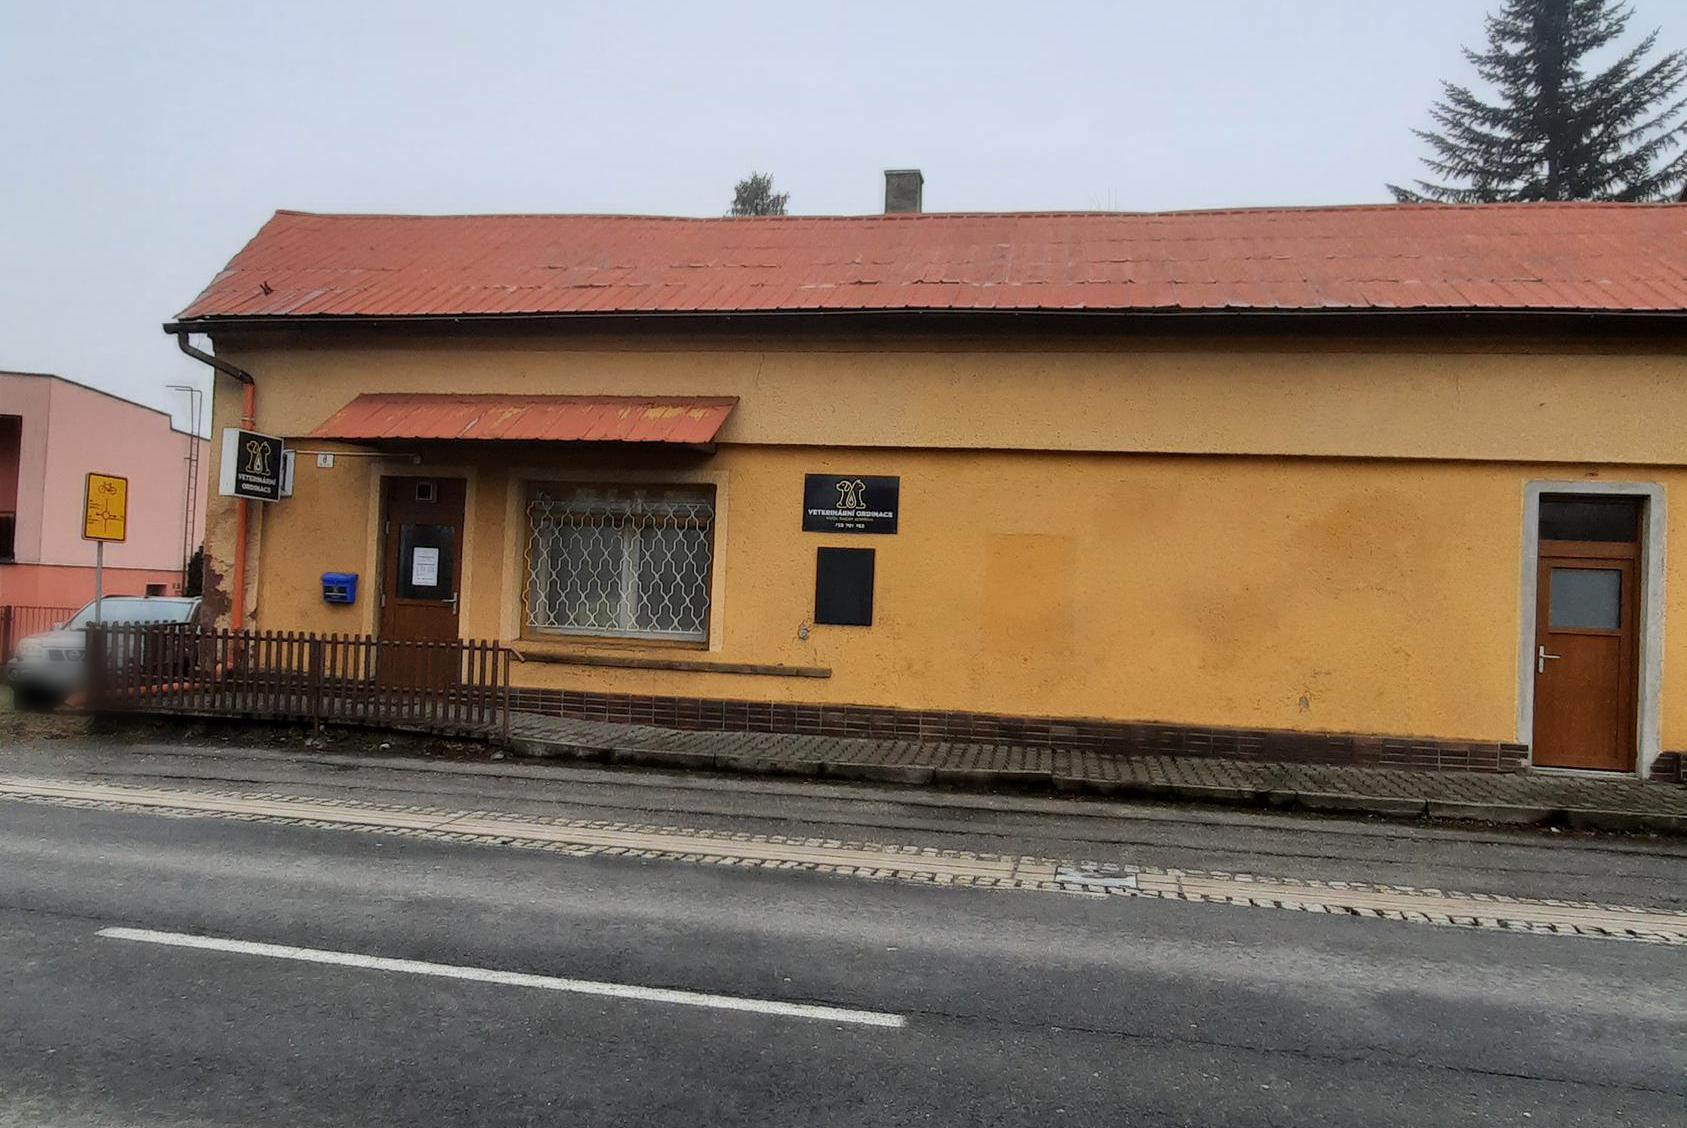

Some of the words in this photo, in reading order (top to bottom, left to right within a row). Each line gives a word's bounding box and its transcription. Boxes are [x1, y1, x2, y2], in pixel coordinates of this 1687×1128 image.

[238, 473, 276, 485] VETERINÁRNÍ
[241, 483, 271, 493] ORDINACE
[808, 509, 855, 517] VETERINÁRNÍ
